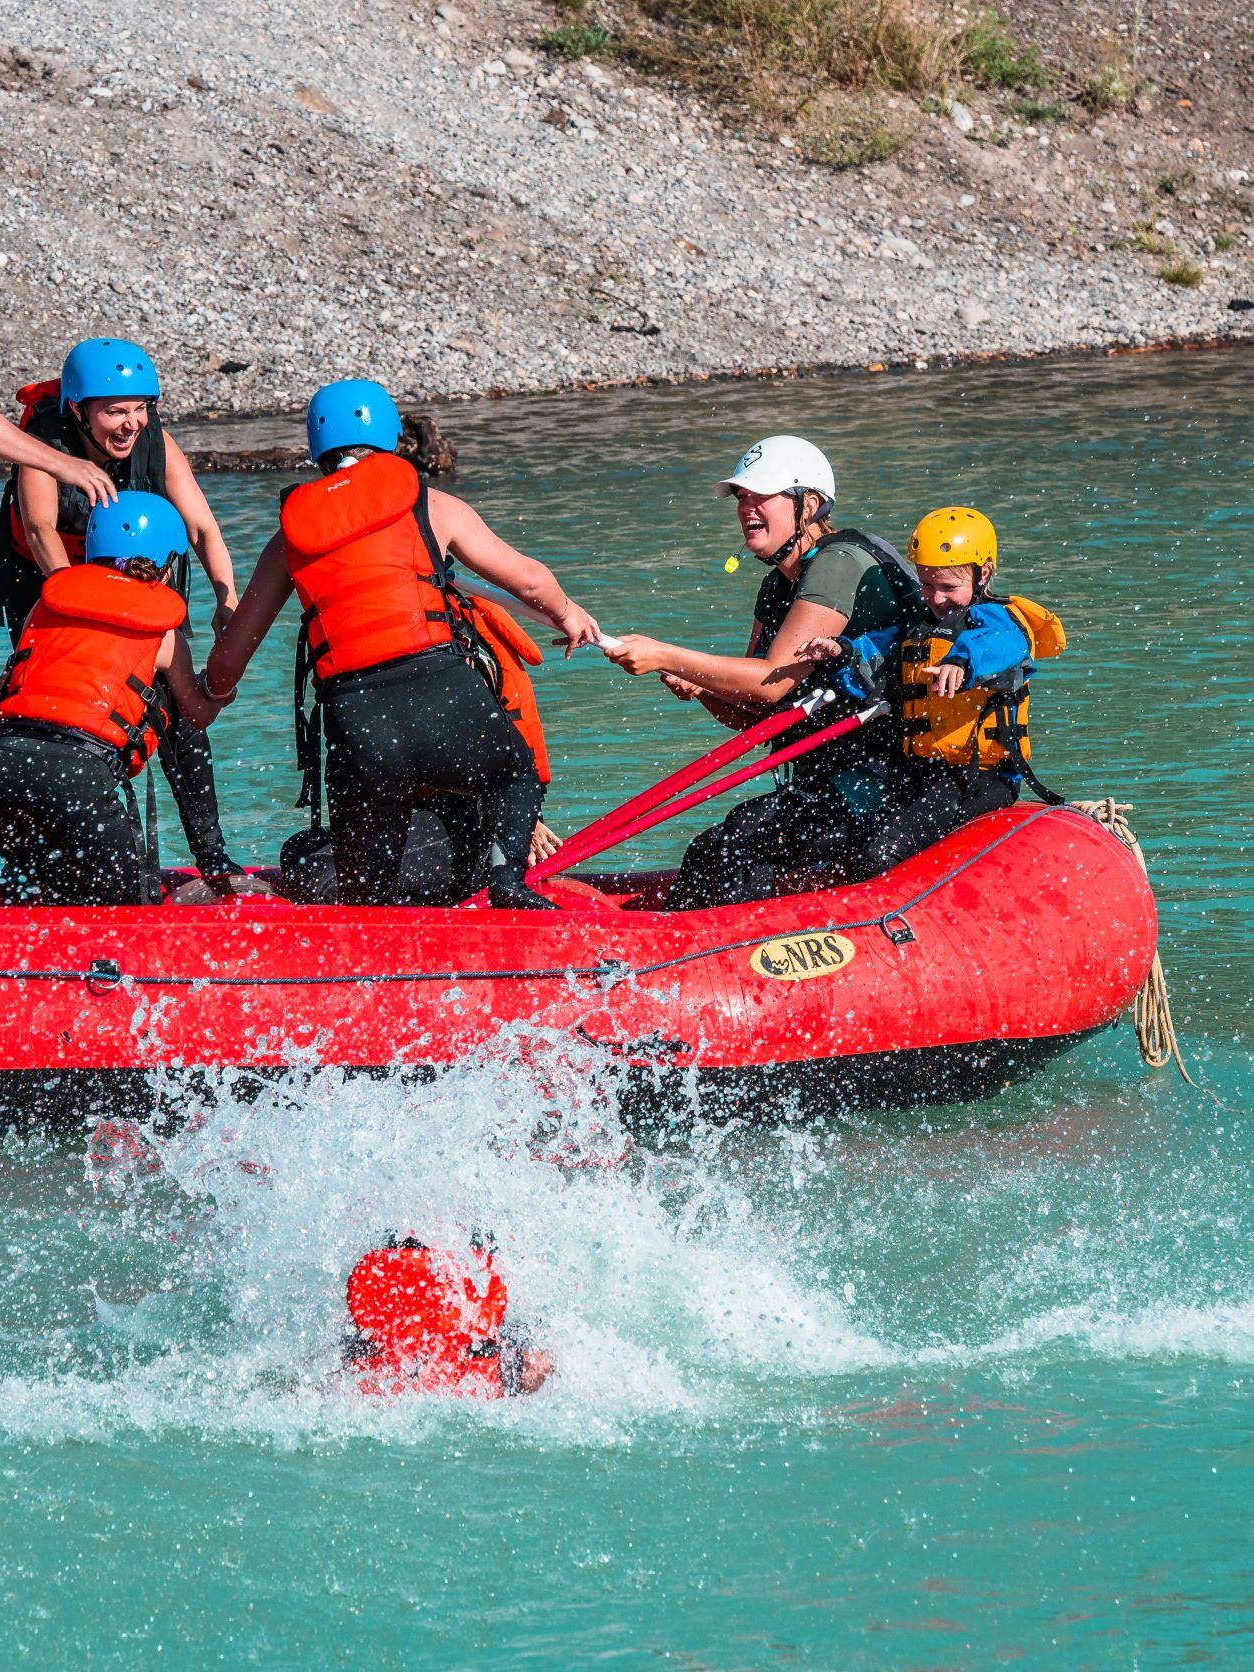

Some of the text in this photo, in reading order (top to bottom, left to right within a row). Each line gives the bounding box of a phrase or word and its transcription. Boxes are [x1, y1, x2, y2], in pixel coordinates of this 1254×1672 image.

[327, 478, 351, 492] NRS
[107, 574, 131, 583] NRS
[933, 627, 953, 635] NRS
[781, 935, 845, 973] NRS
